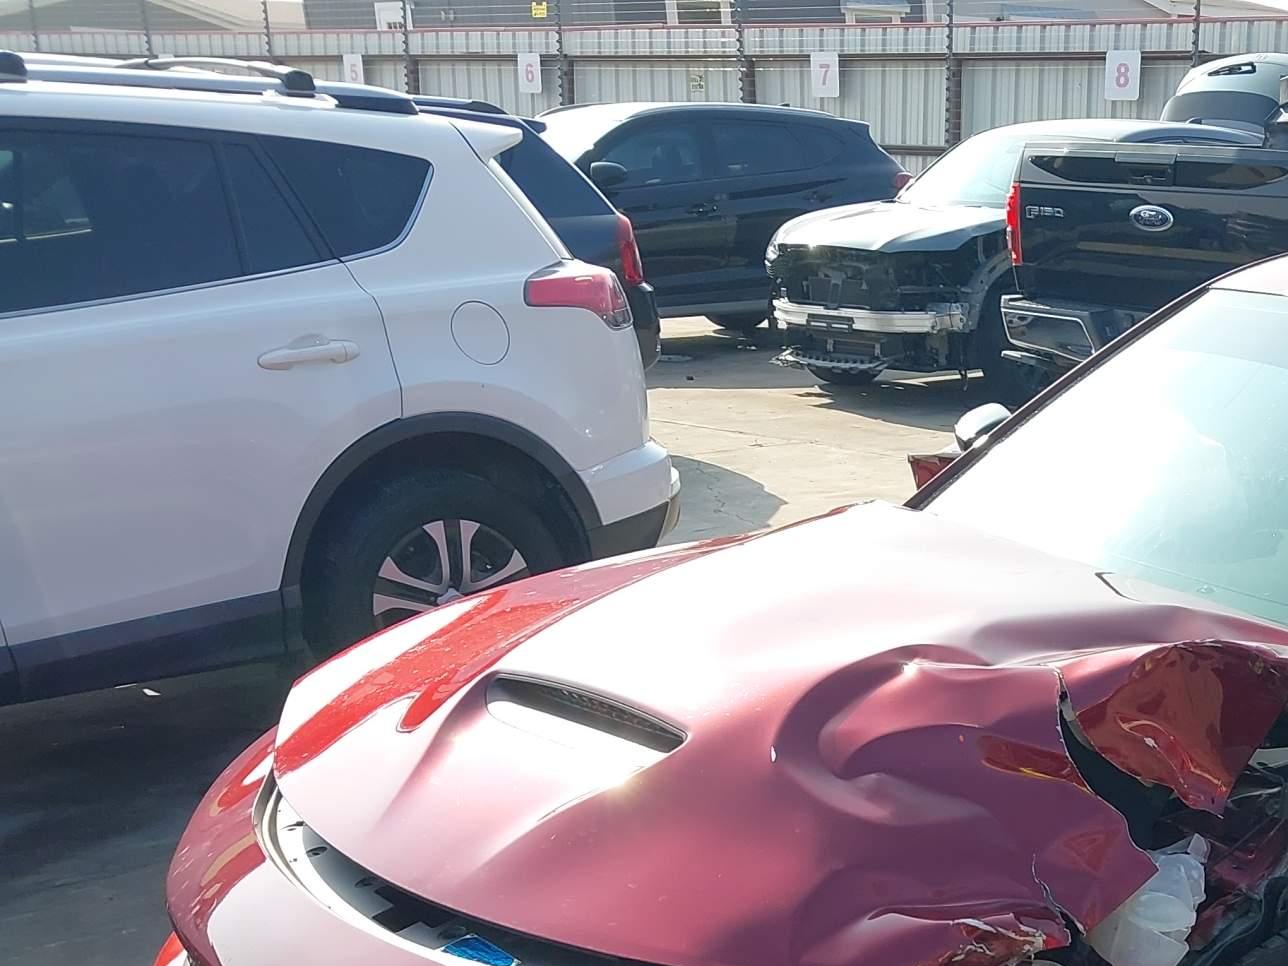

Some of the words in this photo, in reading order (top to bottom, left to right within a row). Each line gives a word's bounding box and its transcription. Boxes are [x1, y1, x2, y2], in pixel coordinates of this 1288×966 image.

[350, 63, 359, 81] 5
[525, 63, 535, 83] 6
[819, 63, 830, 86] 7
[1115, 62, 1130, 89] 8
